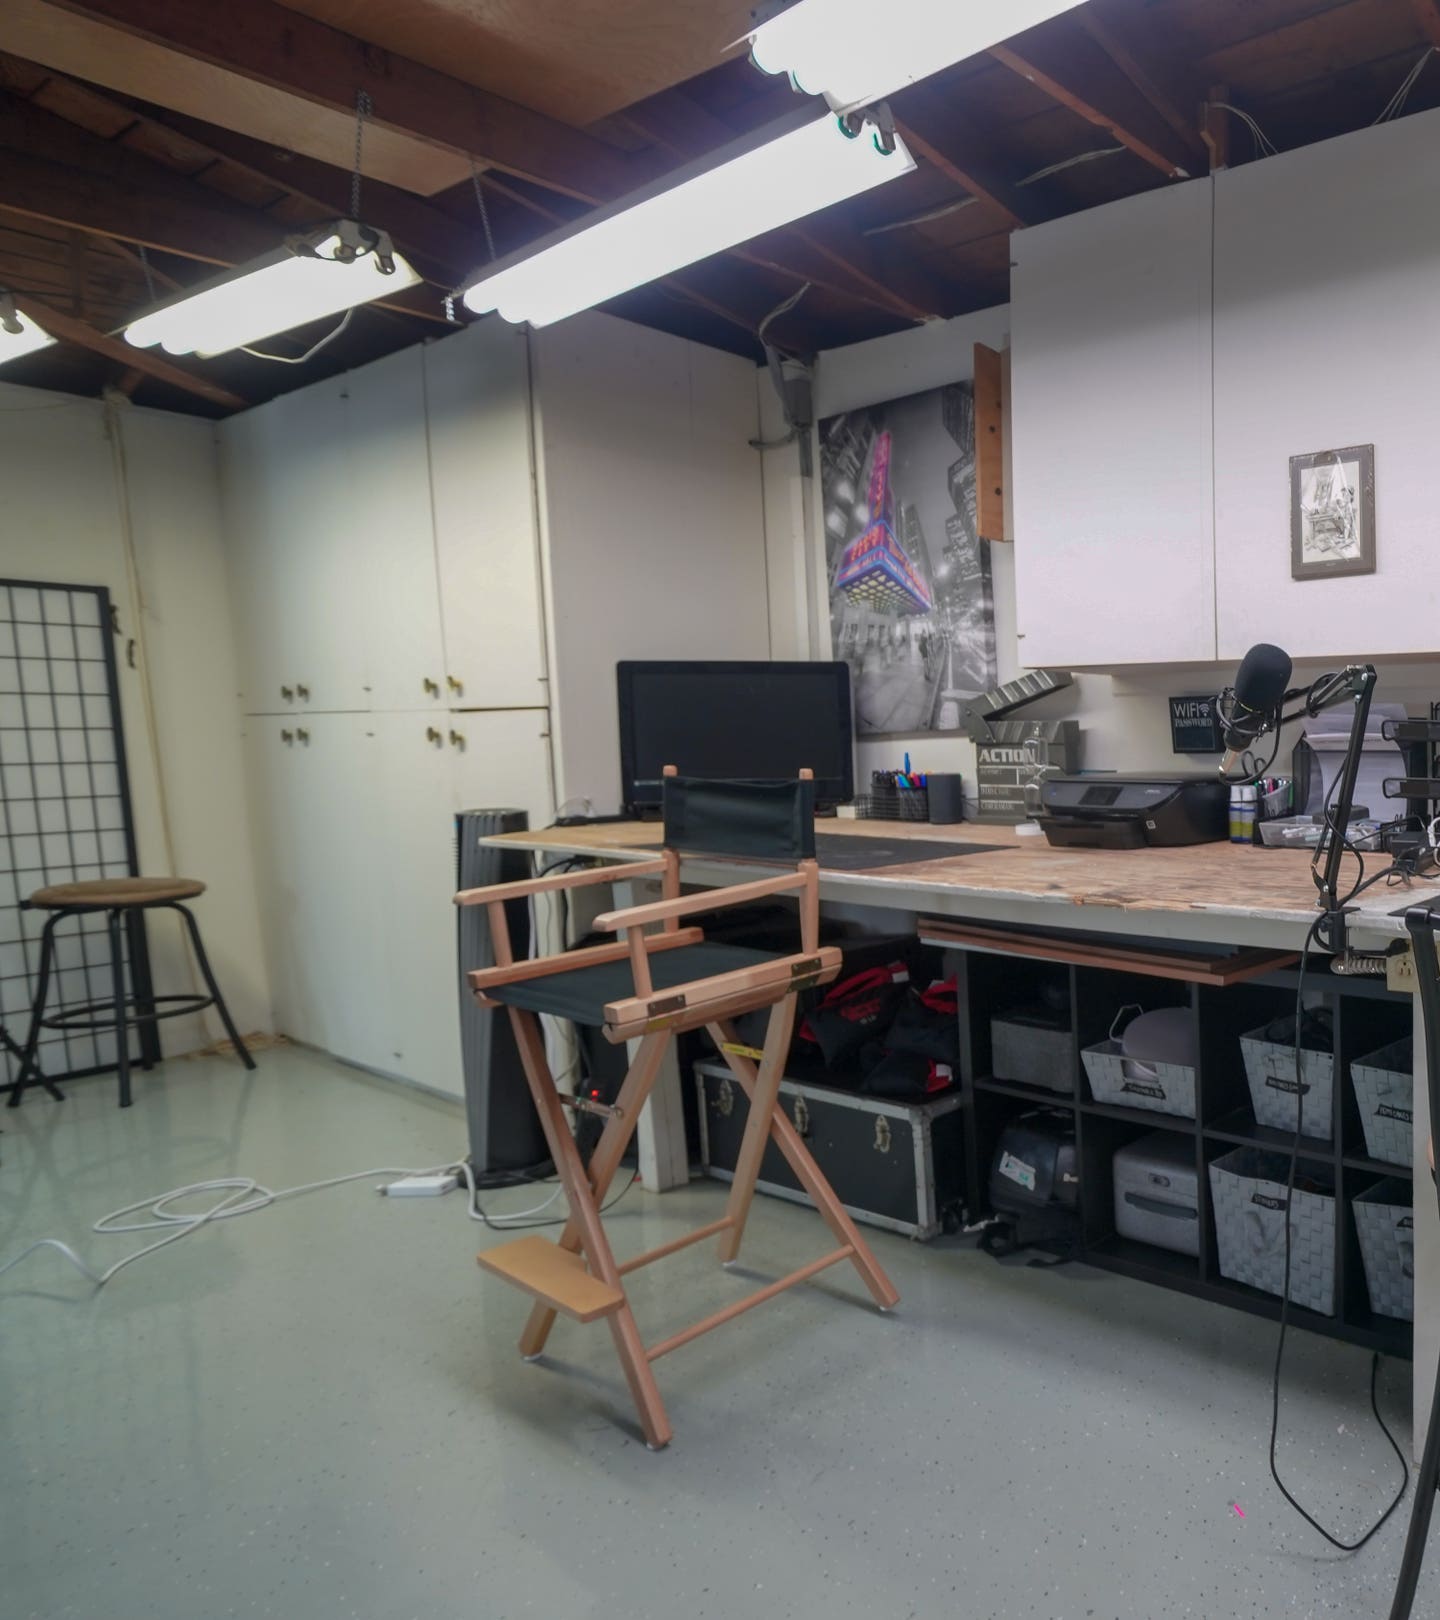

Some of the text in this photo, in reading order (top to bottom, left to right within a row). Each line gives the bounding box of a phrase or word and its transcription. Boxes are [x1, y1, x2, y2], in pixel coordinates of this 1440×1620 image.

[1174, 702, 1199, 718] WIFI
[1174, 718, 1213, 727] PASSWORD
[979, 748, 1035, 763] ACTION
